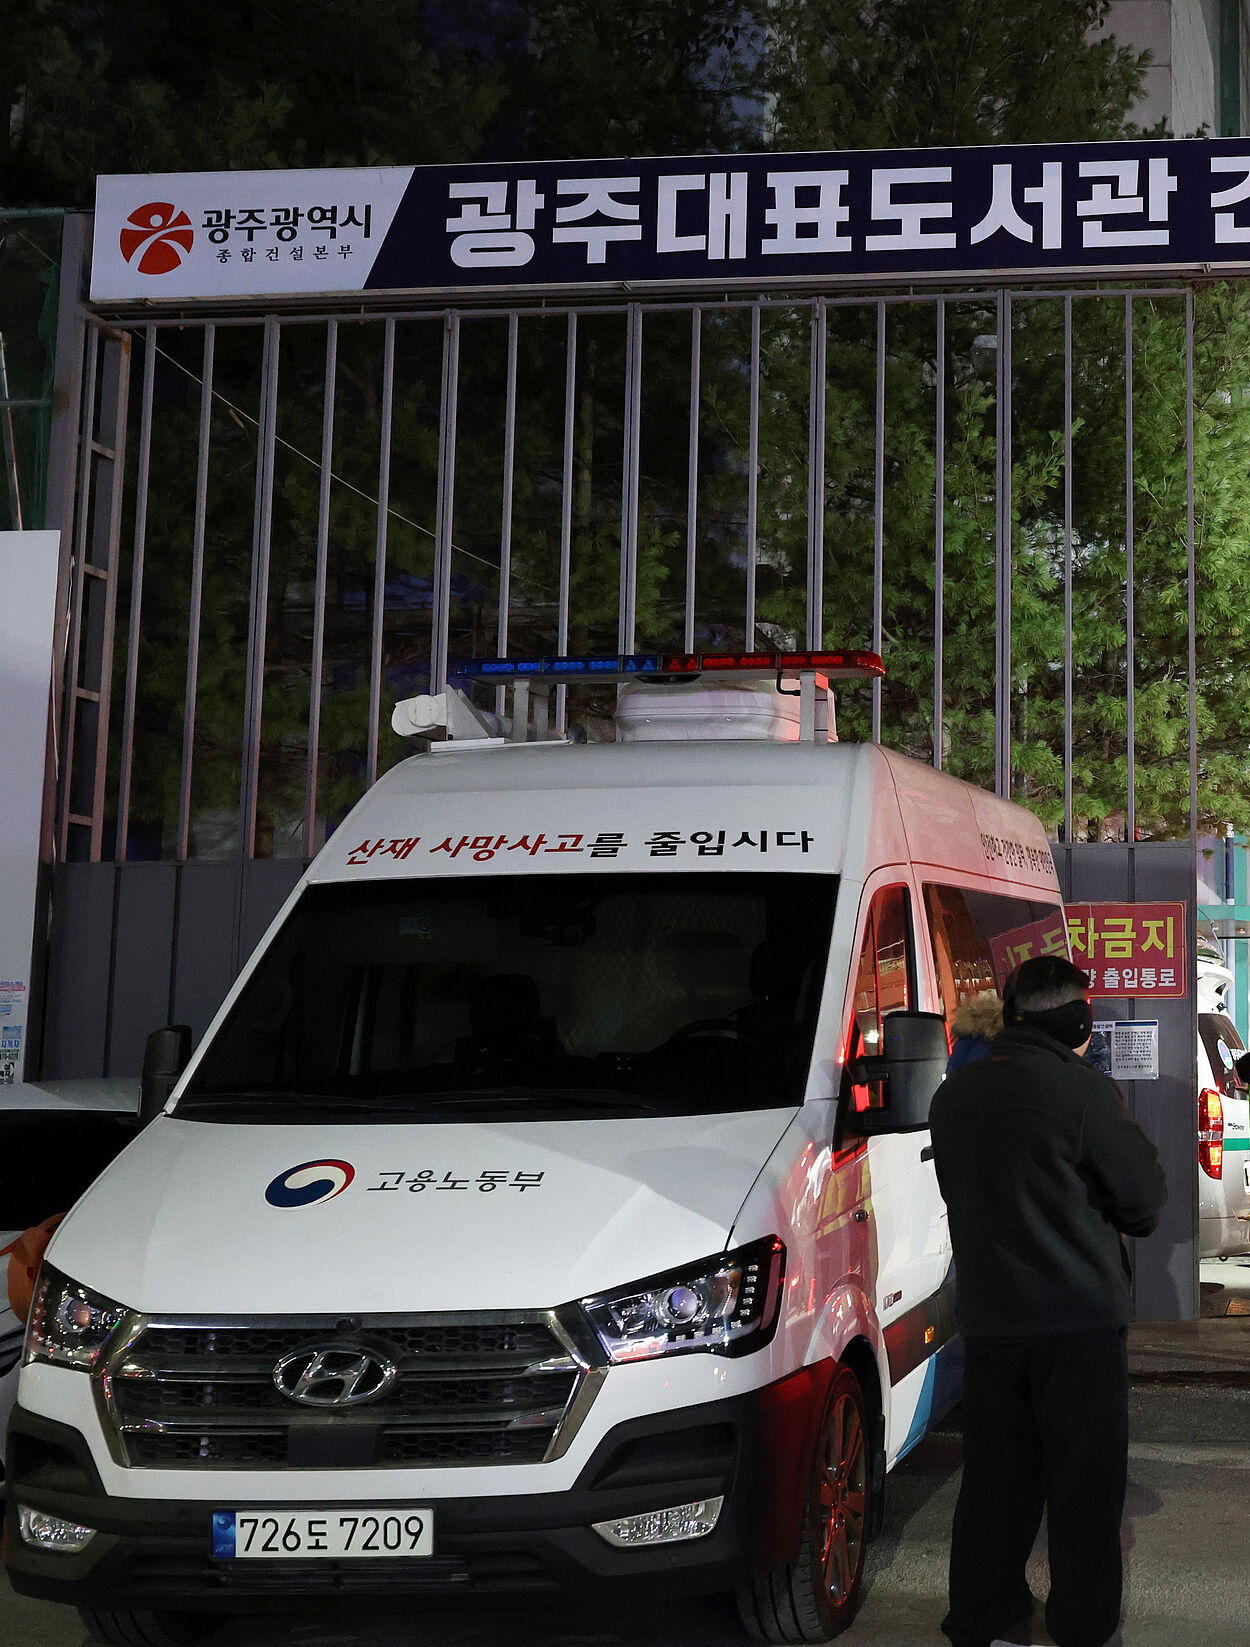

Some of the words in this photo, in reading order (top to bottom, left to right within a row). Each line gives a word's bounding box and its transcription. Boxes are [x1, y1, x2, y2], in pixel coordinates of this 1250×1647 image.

[201, 204, 372, 243] 광주광역시
[445, 155, 1179, 269] 광주대표도서관
[215, 244, 354, 264] 종합건설본부
[345, 837, 420, 866] 산재
[428, 832, 628, 862] 사망사고를
[644, 830, 815, 857] 줄입시다
[1102, 967, 1177, 989] 출입통로
[366, 1169, 545, 1193] 고용노동부
[239, 1517, 328, 1552] 726도
[339, 1515, 425, 1551] 7209
